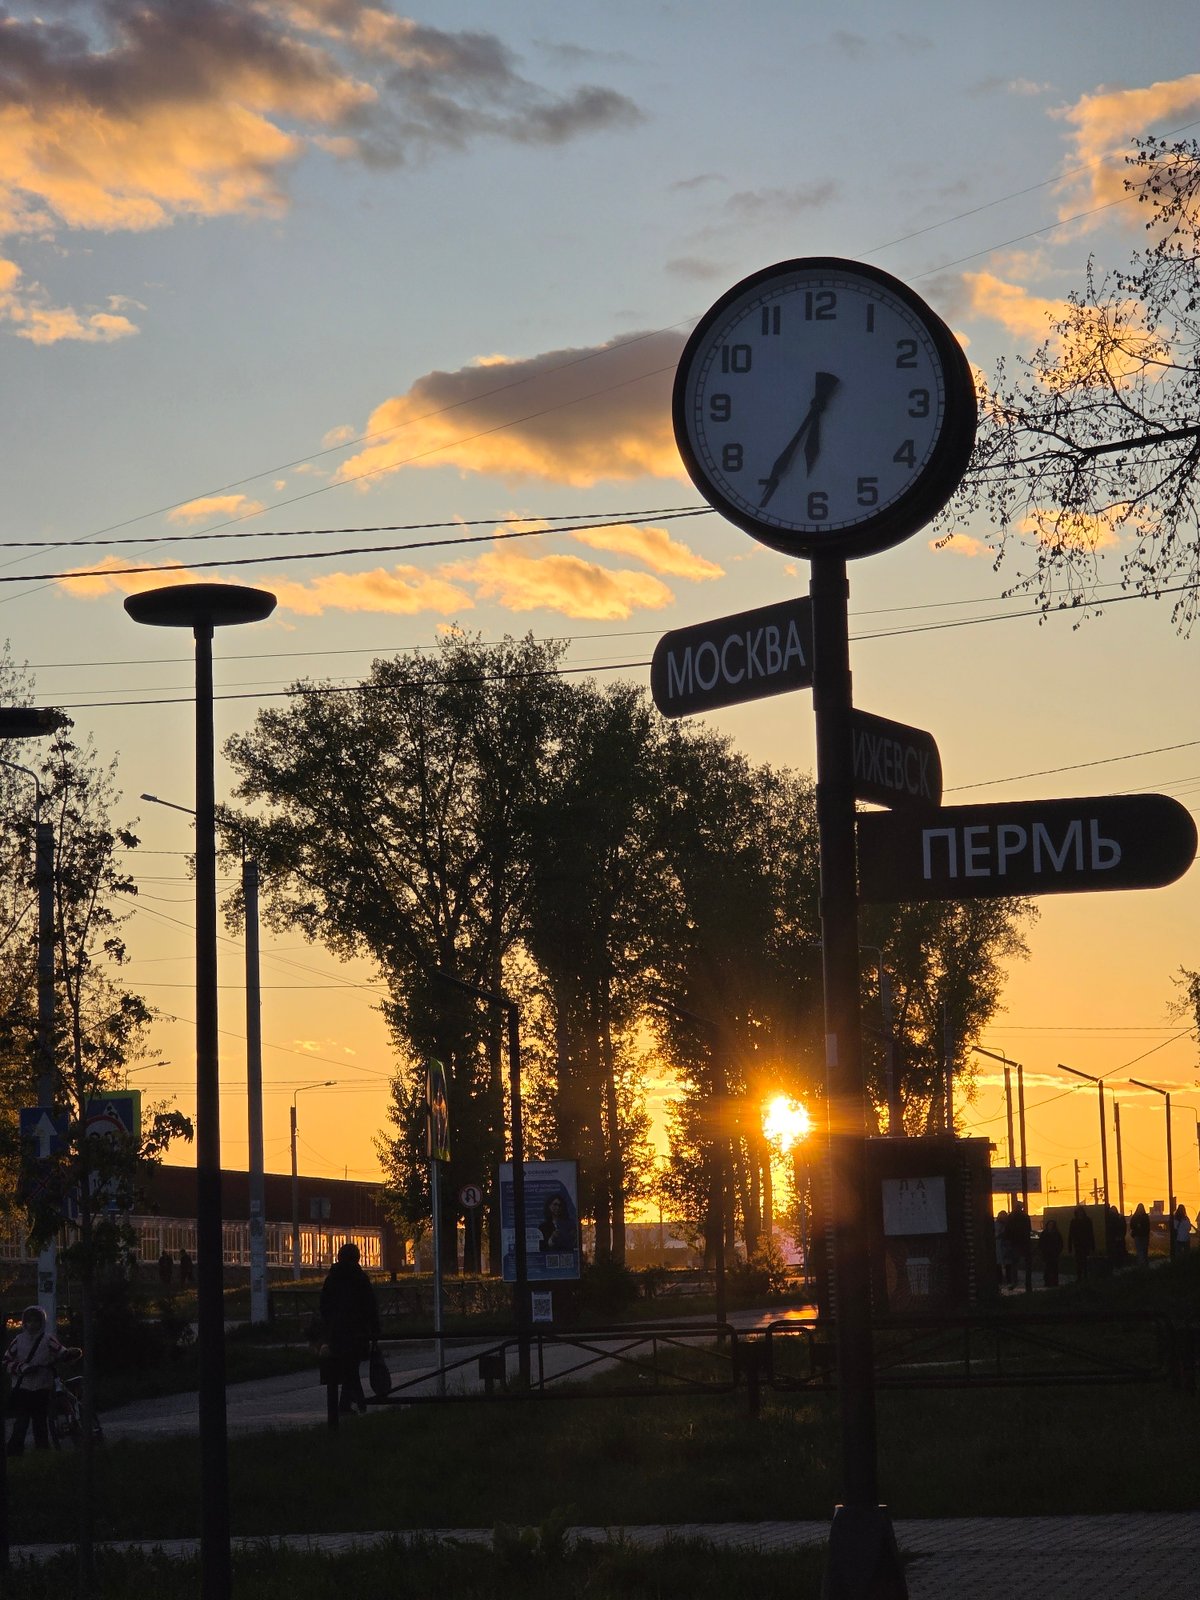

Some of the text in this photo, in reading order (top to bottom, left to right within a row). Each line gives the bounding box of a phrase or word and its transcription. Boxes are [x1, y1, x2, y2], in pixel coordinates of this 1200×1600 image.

[805, 291, 836, 320] 12
[867, 304, 874, 333] 1
[760, 306, 780, 335] 11
[720, 343, 752, 373] 10
[896, 339, 917, 368] 2
[710, 394, 731, 422] 9
[909, 389, 929, 418] 3
[722, 443, 743, 472] 8
[893, 440, 917, 469] 4
[807, 492, 828, 520] 6
[857, 477, 879, 507] 5
[667, 619, 806, 699] МОСКВА
[852, 727, 931, 799] ИЖЕВСК
[922, 819, 1121, 879] ПЕРМЬ
